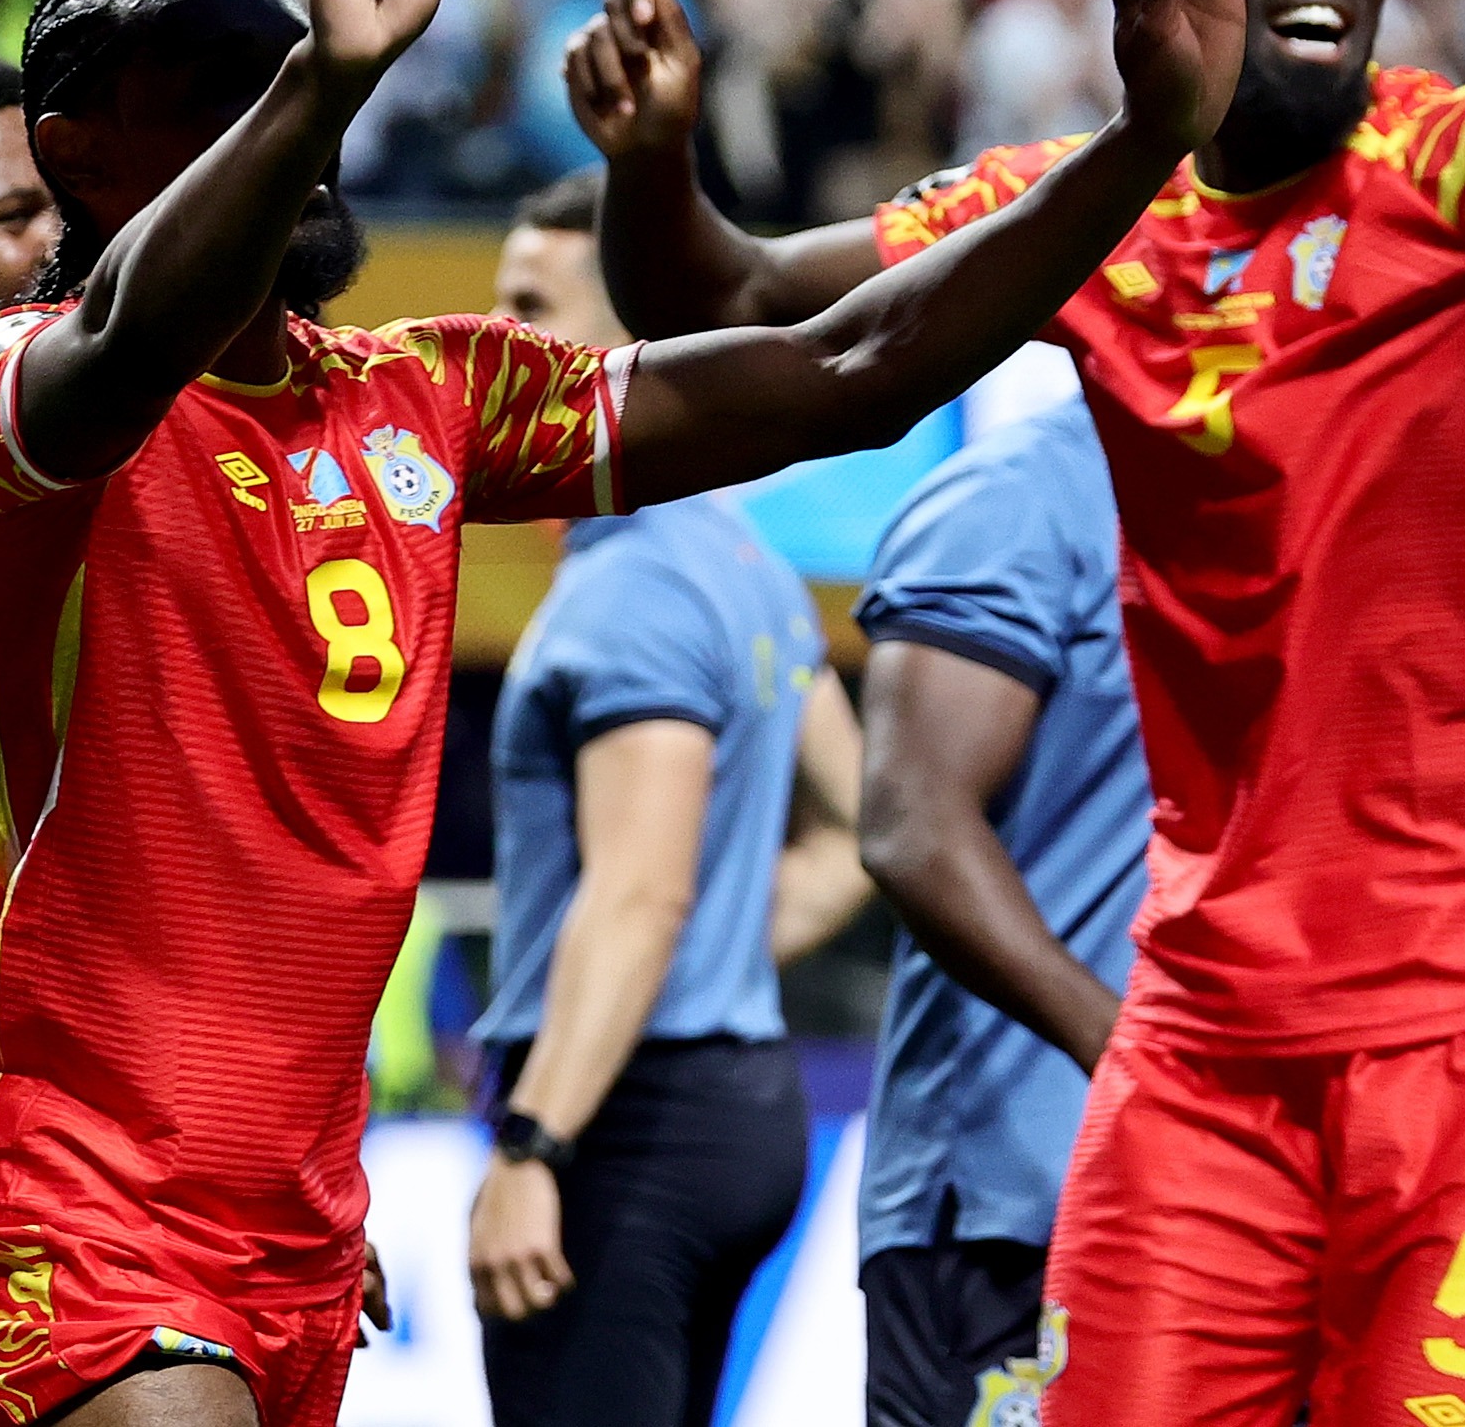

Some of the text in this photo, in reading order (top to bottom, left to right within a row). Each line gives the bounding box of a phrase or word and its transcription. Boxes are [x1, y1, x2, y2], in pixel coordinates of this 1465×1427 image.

[400, 490, 440, 518] FECOFA
[295, 518, 314, 532] 27
[306, 558, 406, 723] 8
